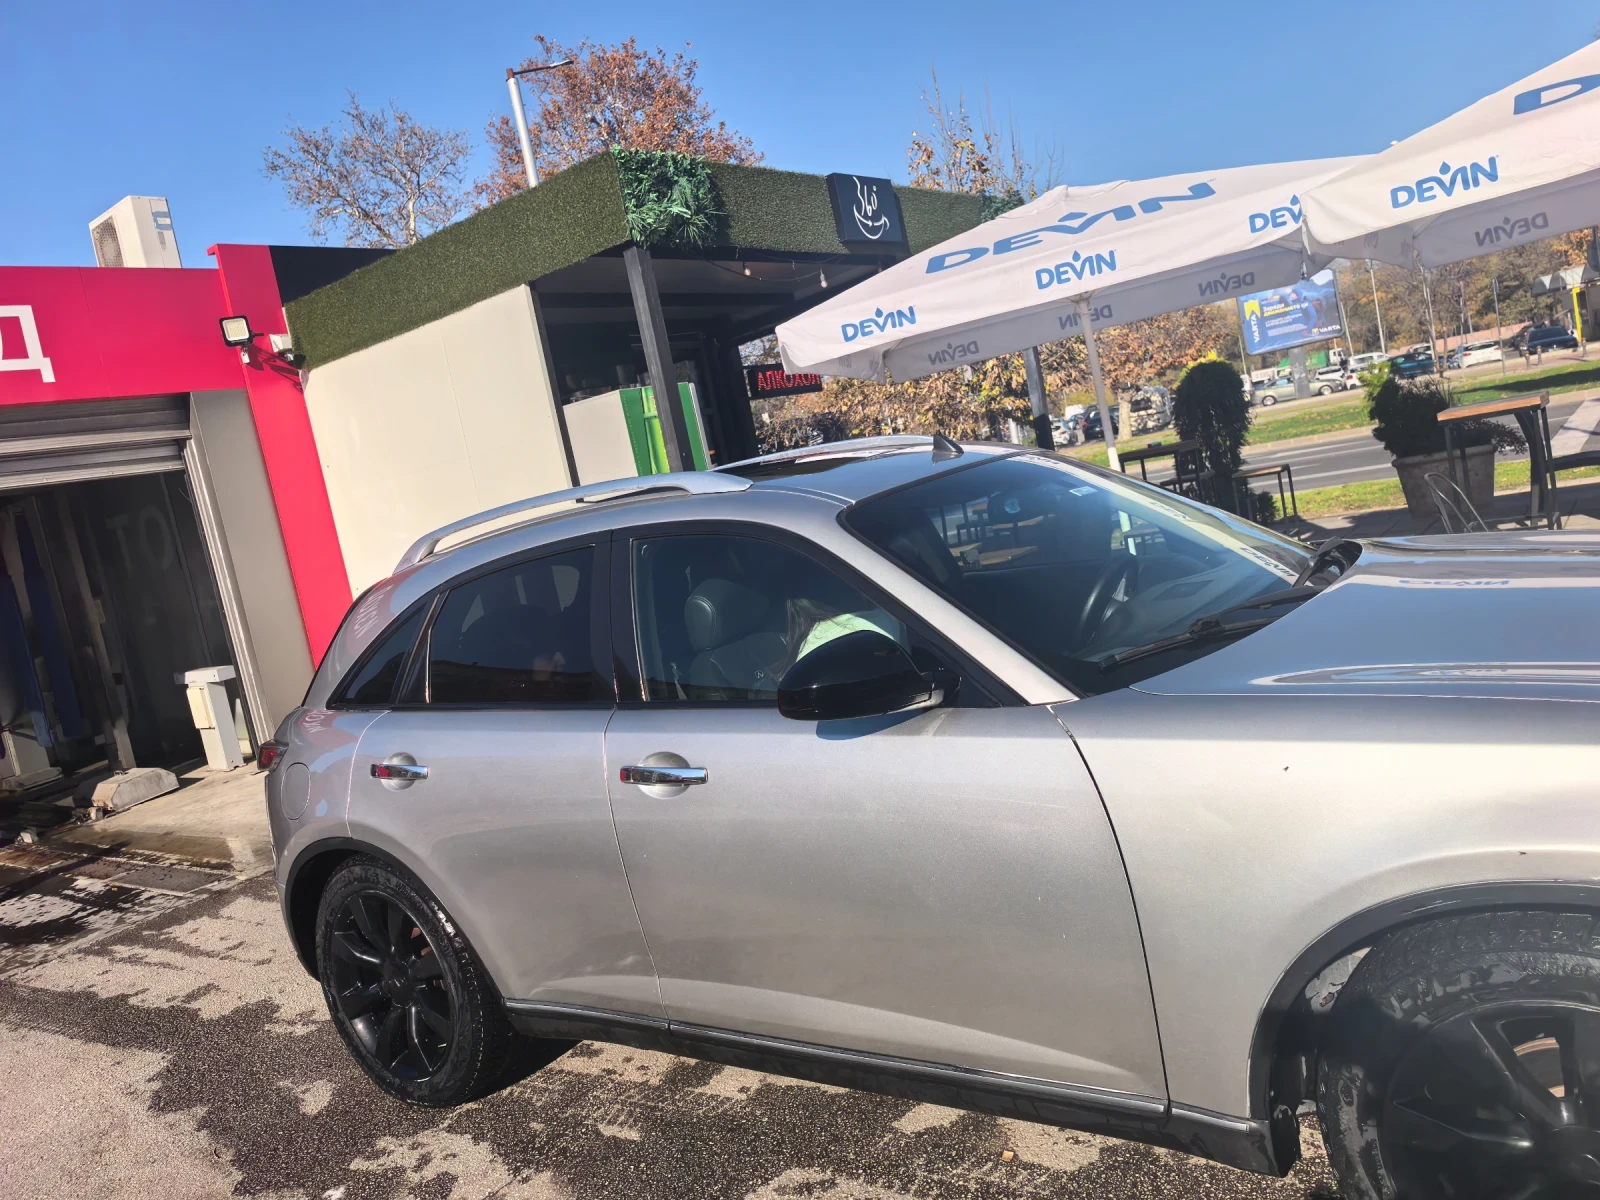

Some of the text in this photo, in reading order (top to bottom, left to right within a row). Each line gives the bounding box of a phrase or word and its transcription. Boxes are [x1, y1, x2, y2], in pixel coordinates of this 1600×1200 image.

[1390, 156, 1498, 209] DEVIN
[926, 181, 1216, 274] DEVIN
[1035, 250, 1116, 290] DEVIN
[841, 306, 916, 342] DEVIN
[1250, 313, 1260, 343] VARTA
[1318, 324, 1341, 333] VARTA
